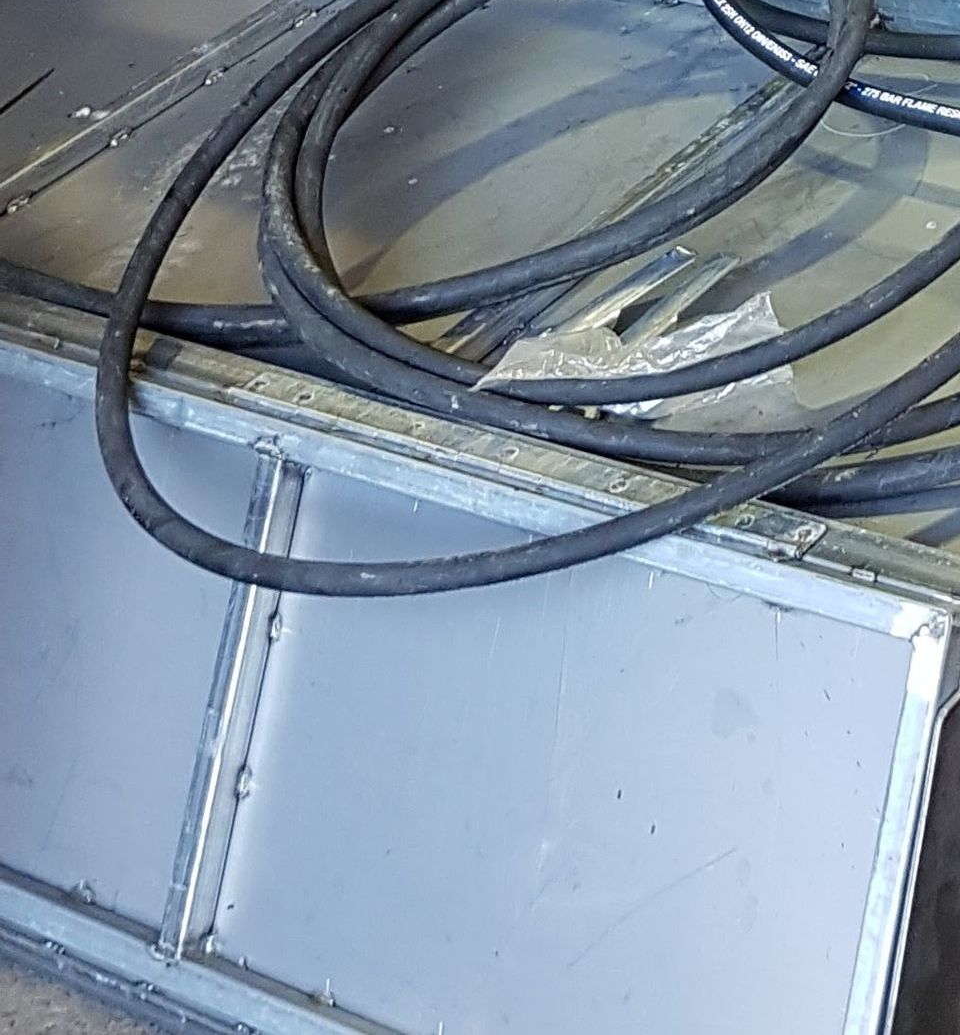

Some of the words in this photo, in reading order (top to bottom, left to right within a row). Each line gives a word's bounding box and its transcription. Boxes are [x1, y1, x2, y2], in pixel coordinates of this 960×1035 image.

[795, 58, 818, 74] SAE
[861, 86, 882, 99] 275
[879, 91, 903, 105] BAR
[901, 97, 938, 114] FLAME
